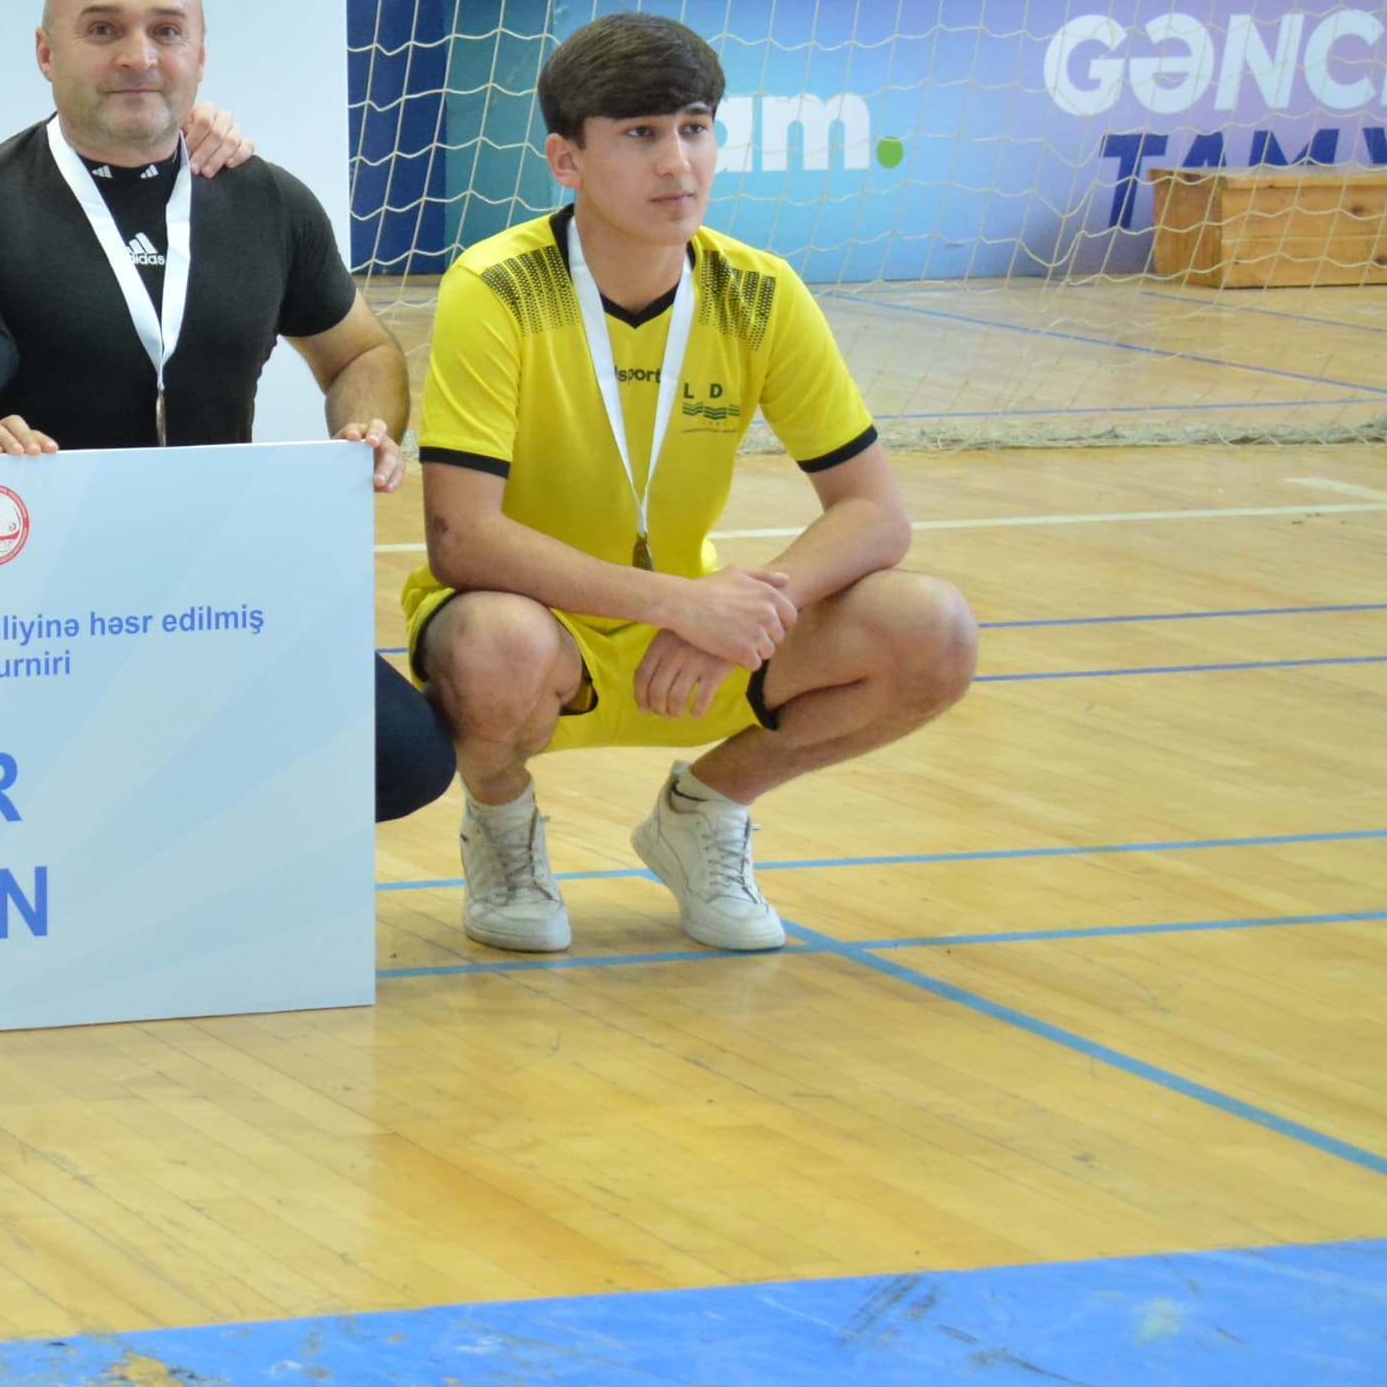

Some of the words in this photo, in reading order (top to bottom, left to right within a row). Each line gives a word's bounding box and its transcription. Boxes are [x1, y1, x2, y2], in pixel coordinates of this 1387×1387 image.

[1043, 8, 1387, 116] GƏNC
[90, 611, 154, 636] həsr
[161, 603, 265, 635] edilmiş
